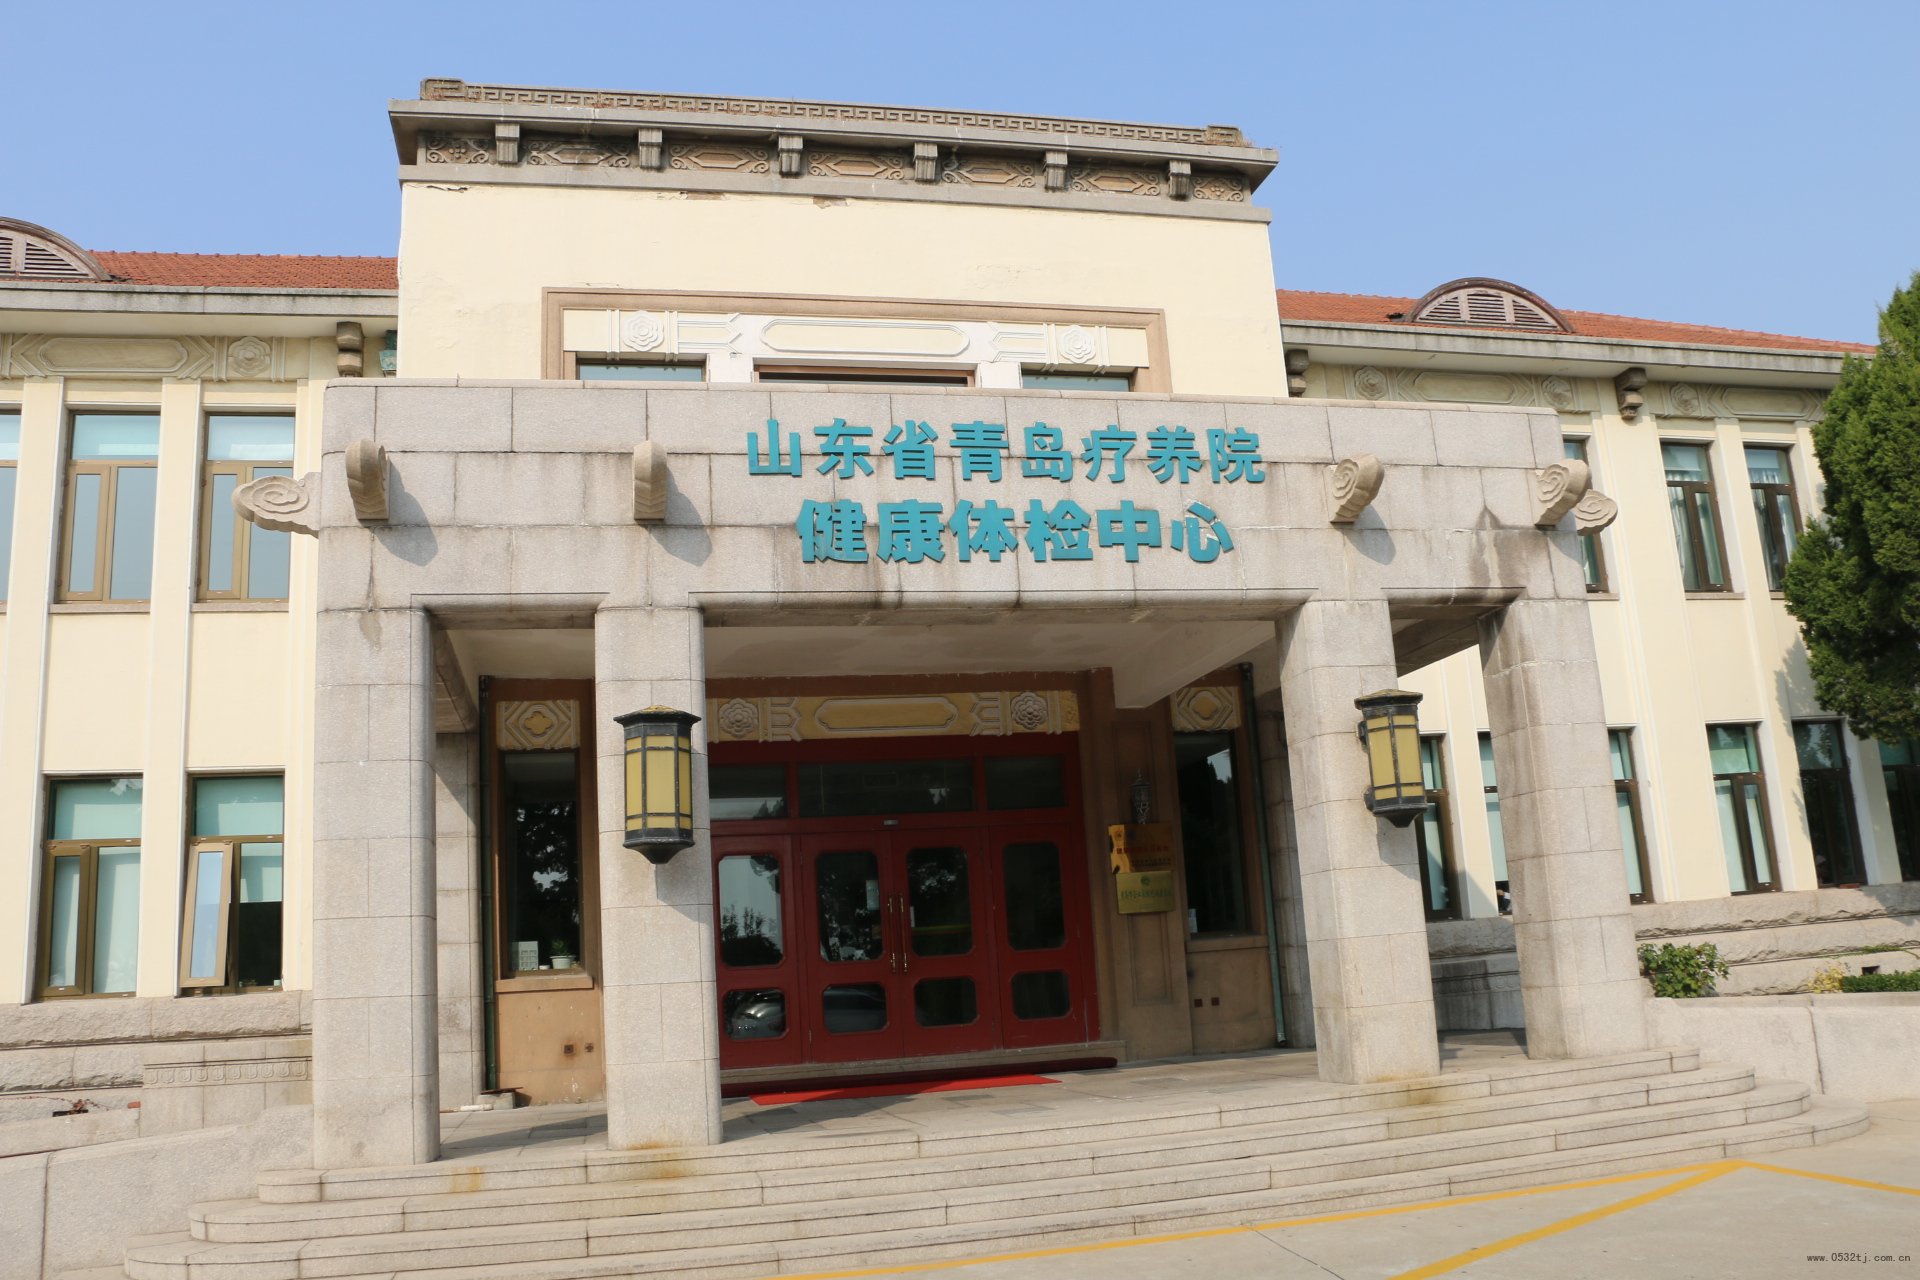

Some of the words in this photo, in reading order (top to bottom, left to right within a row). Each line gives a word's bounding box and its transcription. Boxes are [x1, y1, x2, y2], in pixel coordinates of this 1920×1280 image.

[747, 418, 1265, 483] 山东省青岛疗养院
[797, 499, 1234, 562] 健康体检中心
